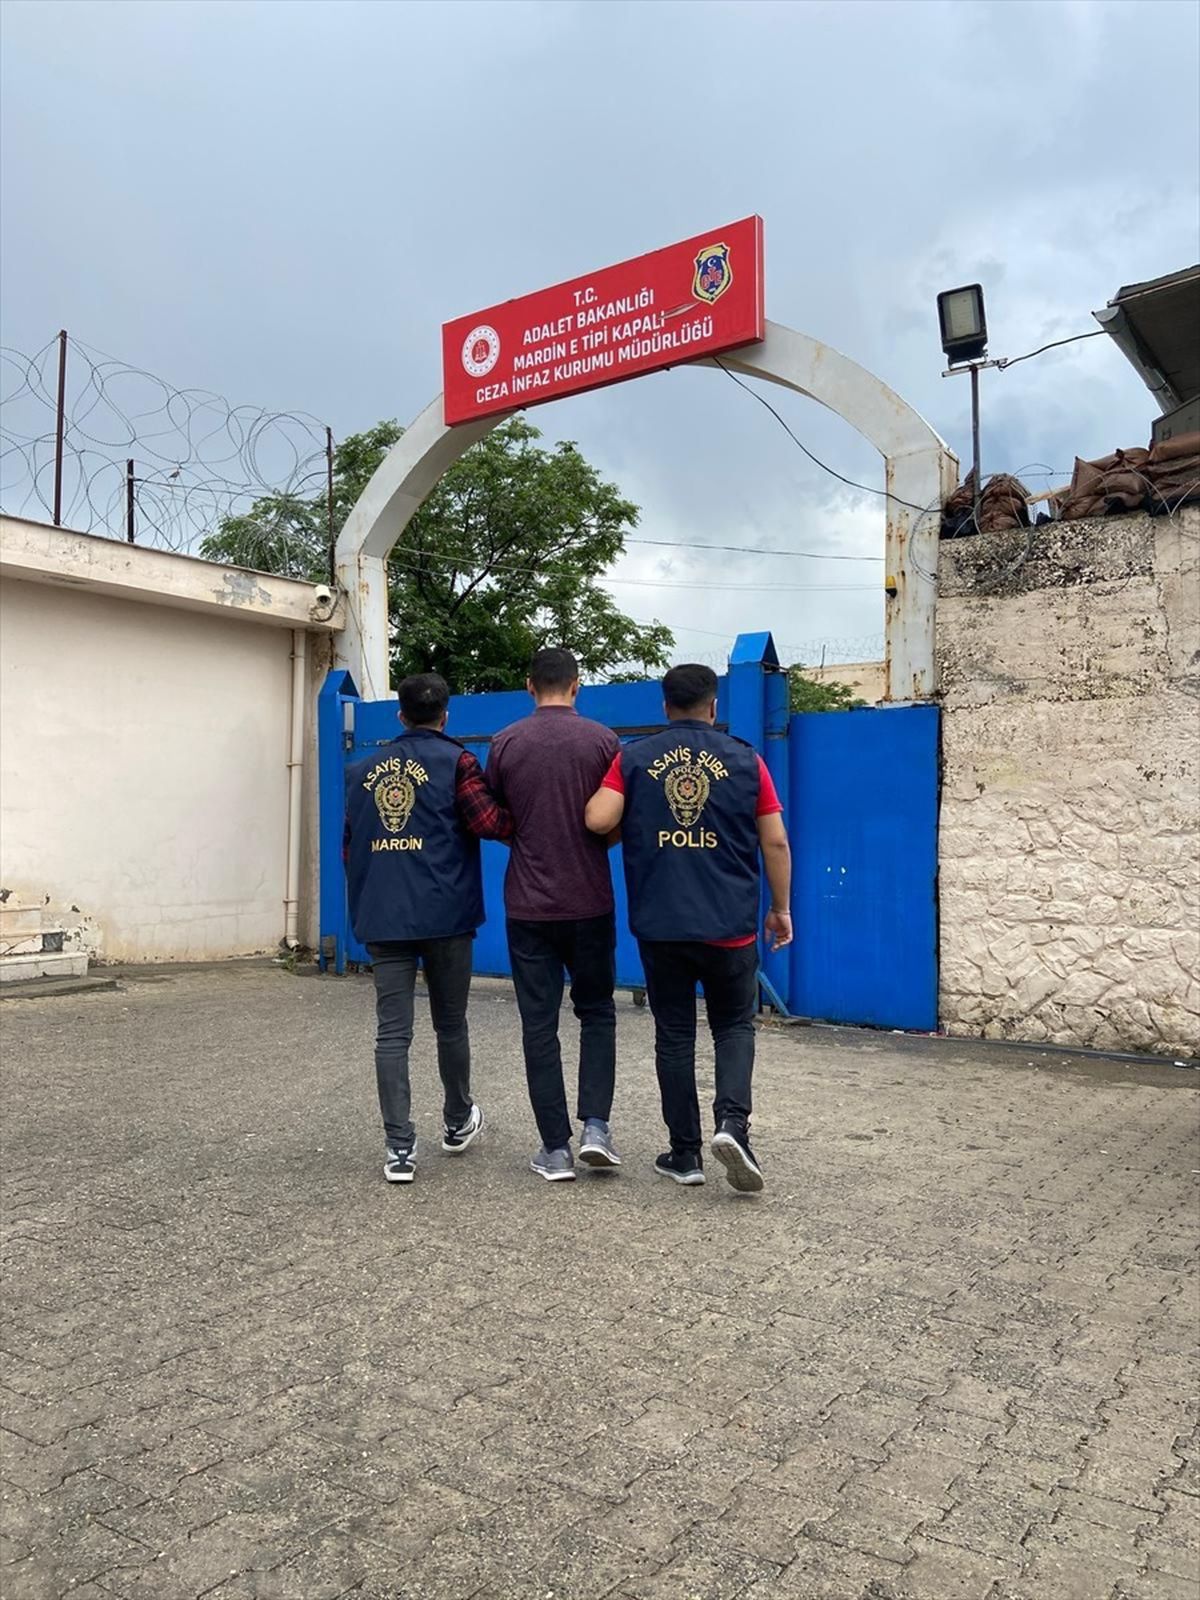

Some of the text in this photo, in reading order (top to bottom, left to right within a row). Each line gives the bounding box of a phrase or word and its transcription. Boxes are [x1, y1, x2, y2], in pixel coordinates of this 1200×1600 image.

[573, 287, 599, 307] T.C.
[523, 287, 654, 346] ADALET BAKANLIĞI
[476, 315, 713, 404] CEZA İNFAZ KURUMU MÜDÜRLÜĞÜ
[513, 341, 567, 372] MARDİN
[570, 339, 578, 356] E
[581, 325, 608, 351] TİPİ
[371, 835, 423, 852] MARDİN
[658, 827, 718, 848] POLİS
